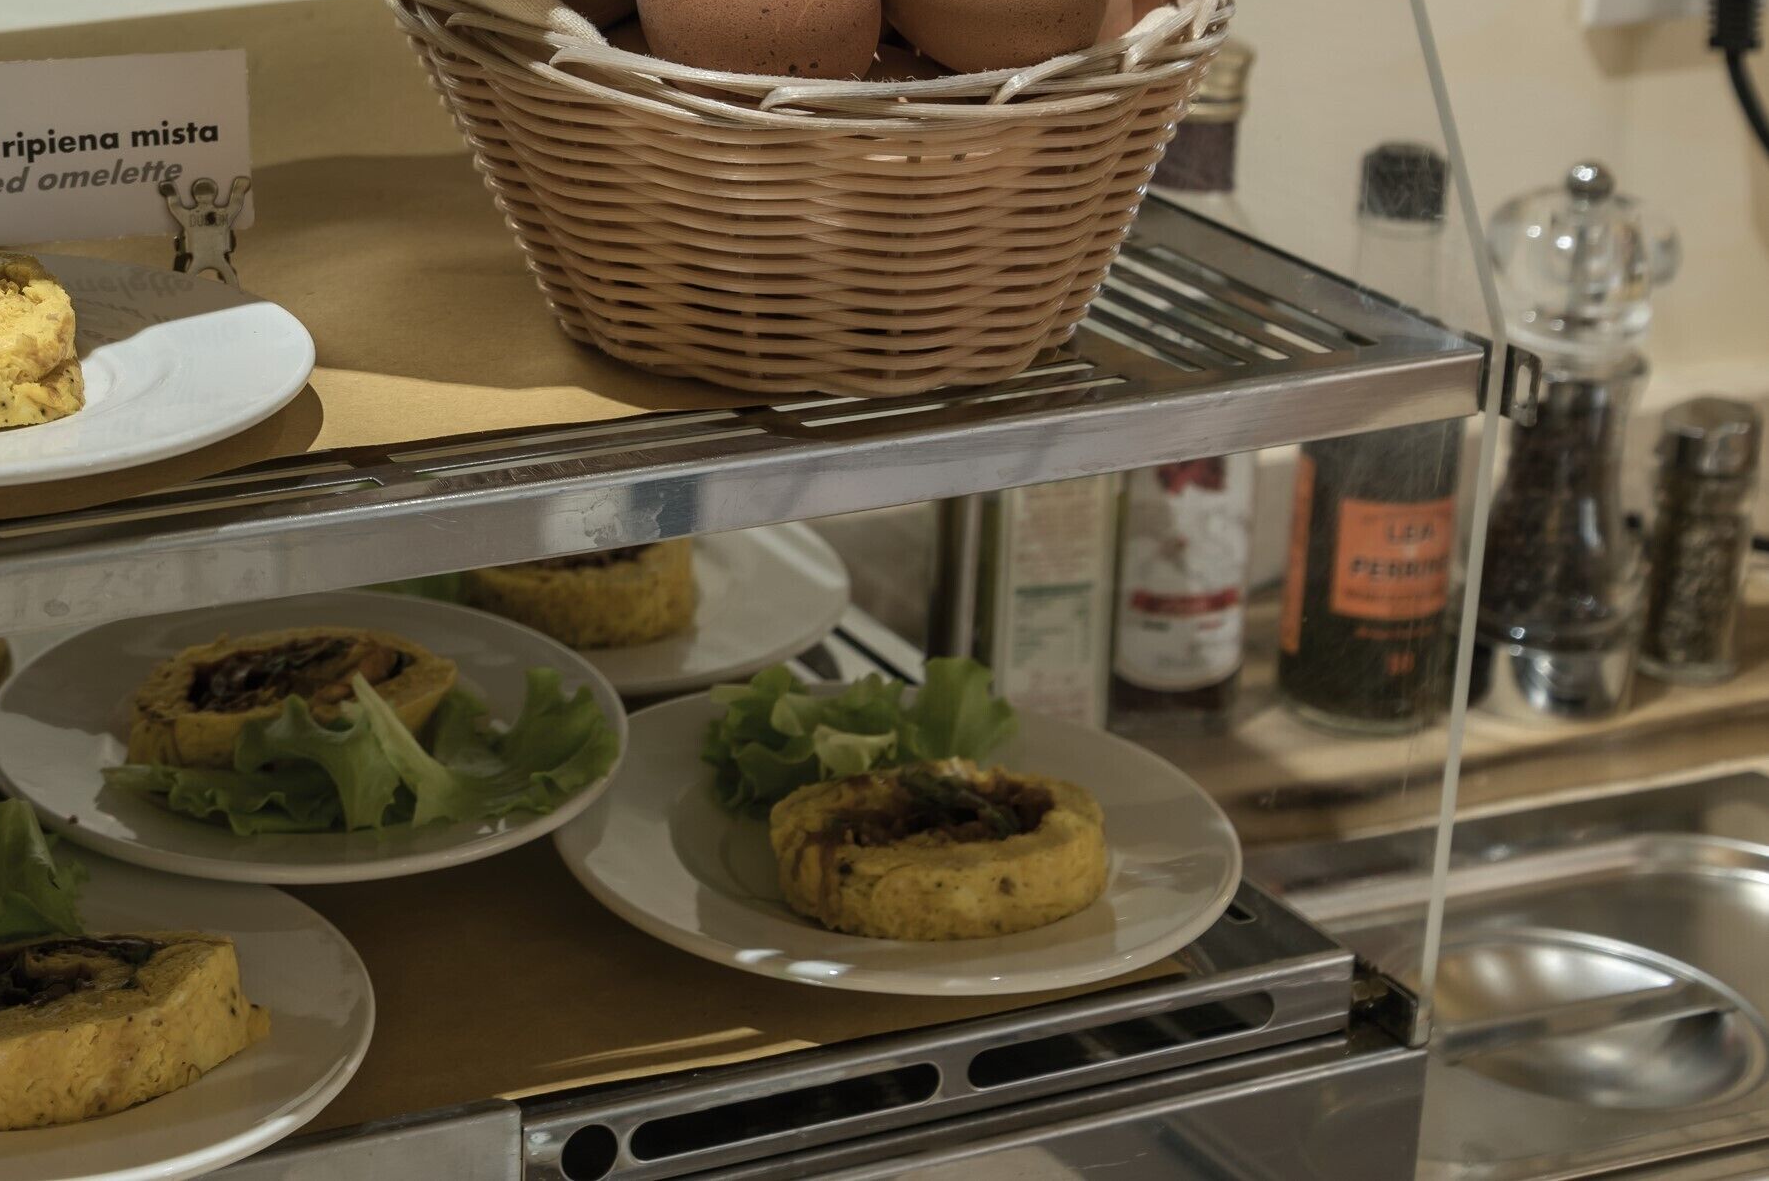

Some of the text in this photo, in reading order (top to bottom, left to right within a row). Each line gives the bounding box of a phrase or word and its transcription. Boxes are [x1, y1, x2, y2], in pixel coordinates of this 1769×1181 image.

[2, 130, 120, 164] ripiena
[131, 120, 219, 148] mista
[37, 159, 183, 192] omelette
